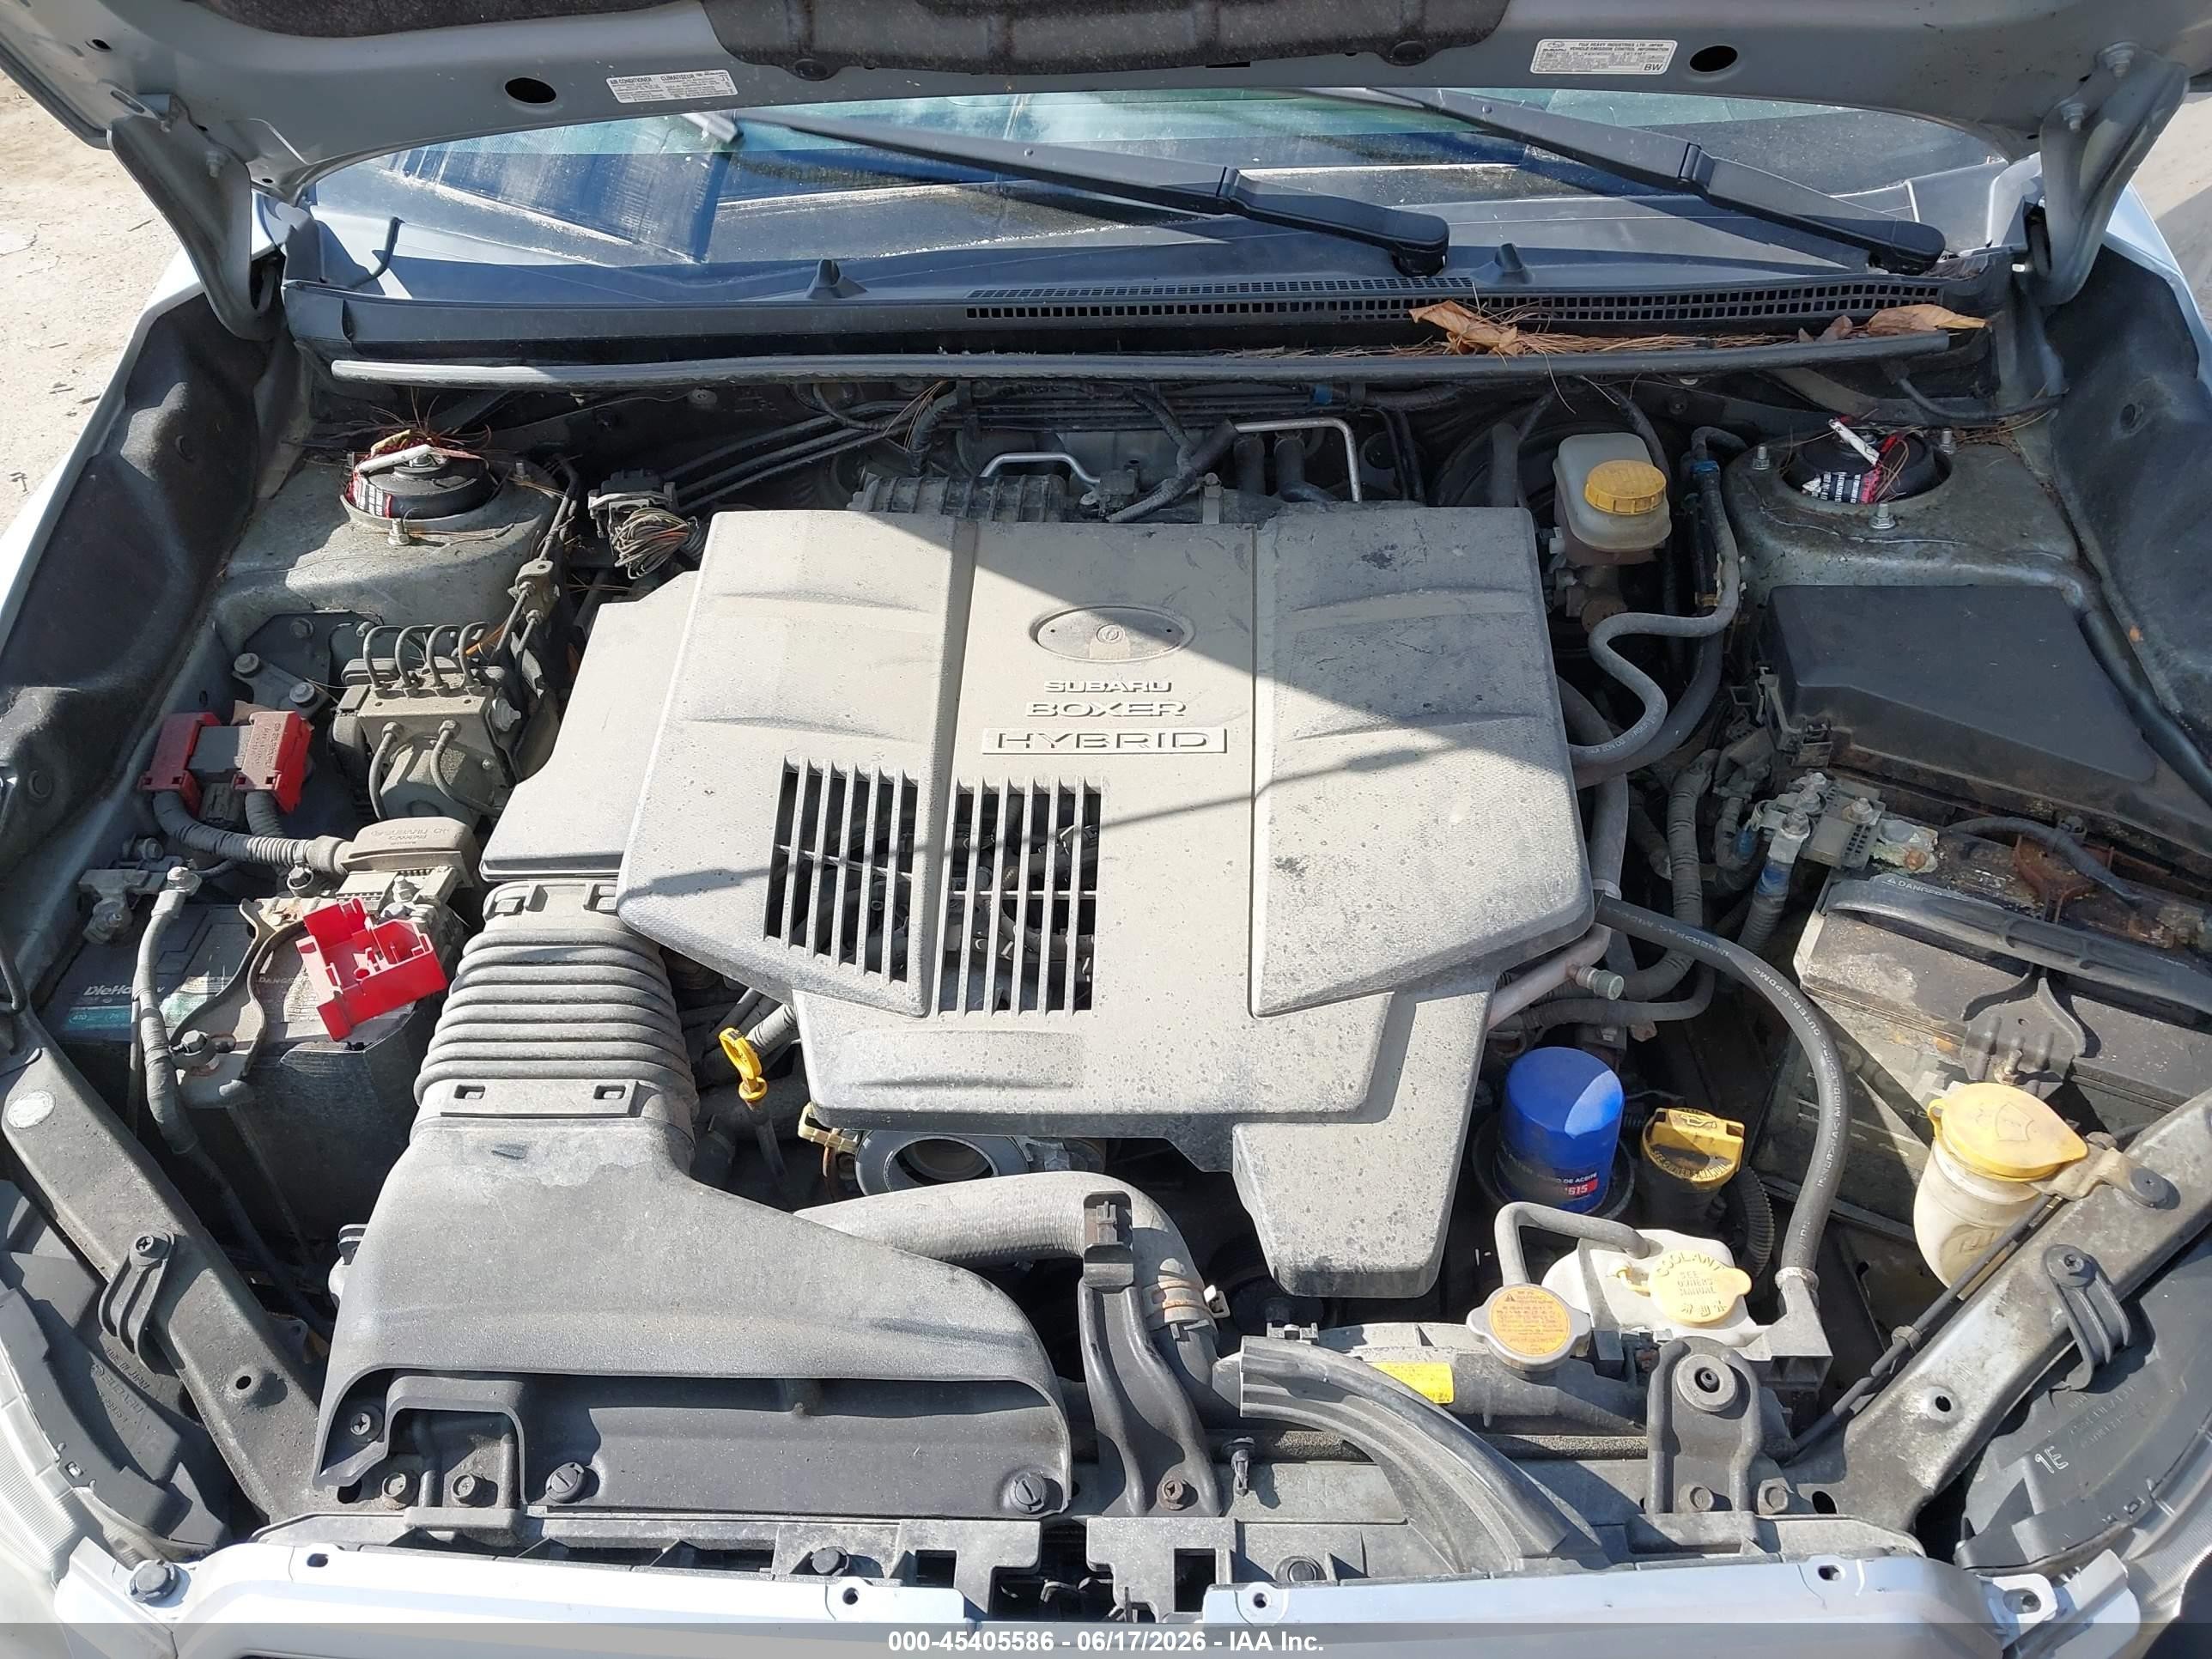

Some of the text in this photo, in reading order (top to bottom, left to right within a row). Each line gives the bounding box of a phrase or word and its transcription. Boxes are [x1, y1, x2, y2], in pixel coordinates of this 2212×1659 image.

[1044, 680, 1173, 693] SUBARU
[1026, 701, 1188, 717] BOXER
[996, 732, 1210, 749] HYBRID
[1656, 1252, 1725, 1277] COOLANT
